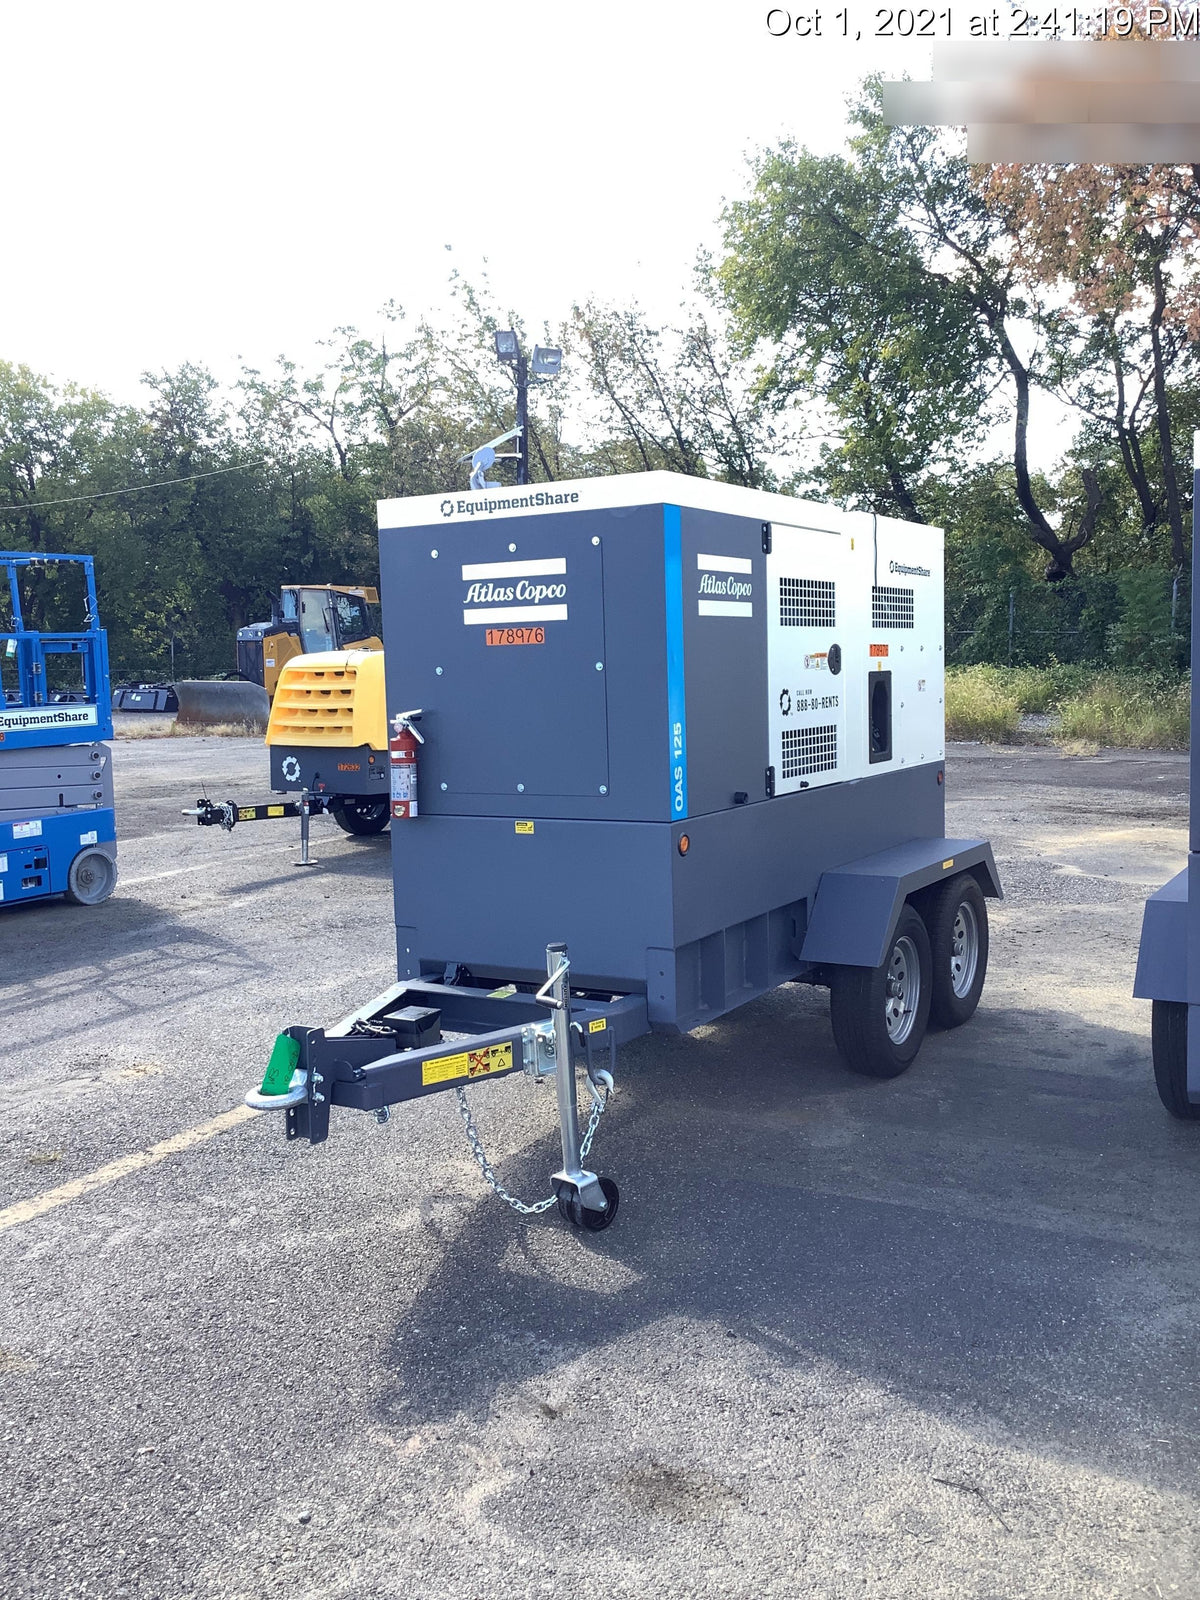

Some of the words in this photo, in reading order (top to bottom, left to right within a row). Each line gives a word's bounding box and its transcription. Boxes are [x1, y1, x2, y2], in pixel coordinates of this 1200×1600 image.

[456, 492, 579, 515] EquipmentShare
[895, 562, 931, 577] EquipmentShare
[487, 627, 544, 645] 178976
[796, 695, 839, 712] 888-80-RENTS
[673, 722, 683, 759] 125
[674, 765, 684, 812] QAS
